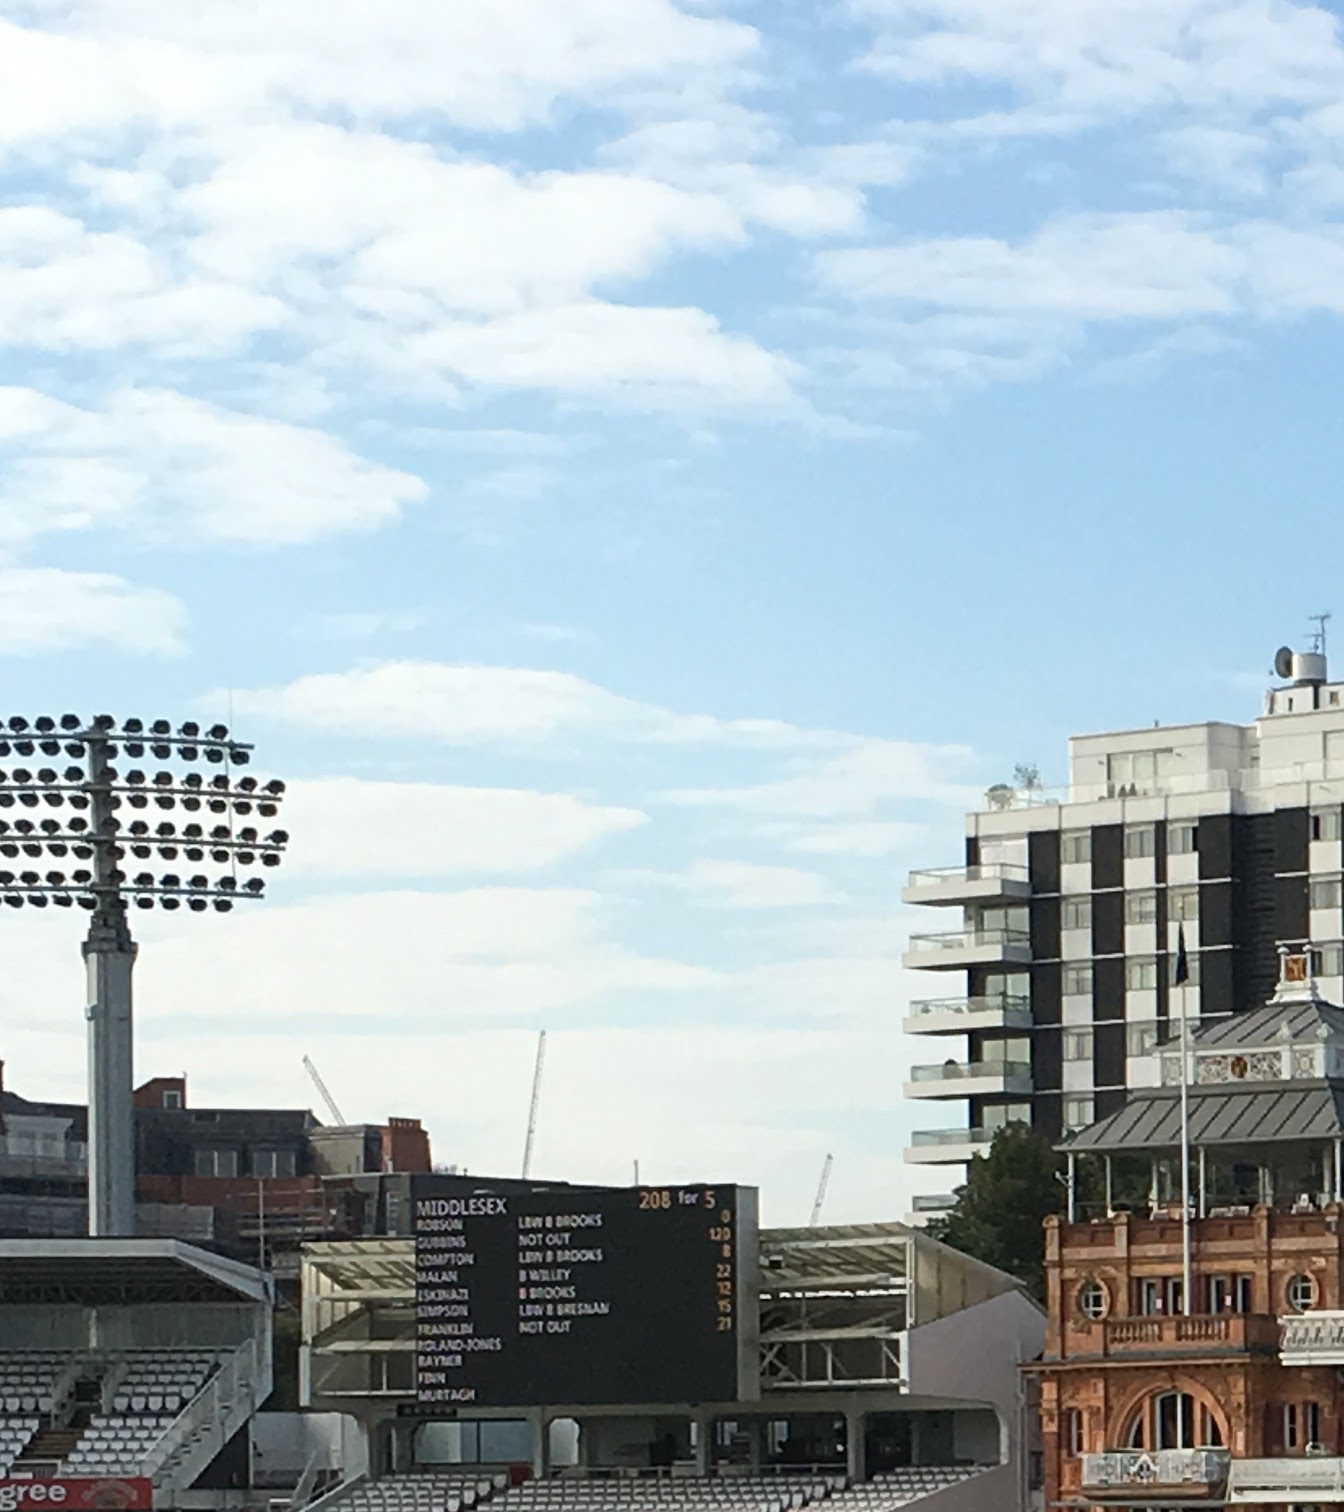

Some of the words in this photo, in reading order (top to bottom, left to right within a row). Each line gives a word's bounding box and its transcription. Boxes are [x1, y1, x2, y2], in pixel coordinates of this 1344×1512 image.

[417, 1199, 507, 1216] MIDDLESEX
[639, 1191, 671, 1209] 208
[678, 1189, 698, 1204] for
[704, 1190, 715, 1209] 5
[556, 1214, 602, 1227] BROOKS
[519, 1234, 542, 1246] NOT
[545, 1233, 570, 1246] OUT
[418, 1252, 474, 1266] COMPTON
[529, 1268, 571, 1282] WILLEY
[716, 1264, 731, 1278] 22
[529, 1285, 576, 1299] BROOKS
[519, 1322, 543, 1333] NOT
[546, 1320, 571, 1333] OUT
[717, 1316, 731, 1331] 21
